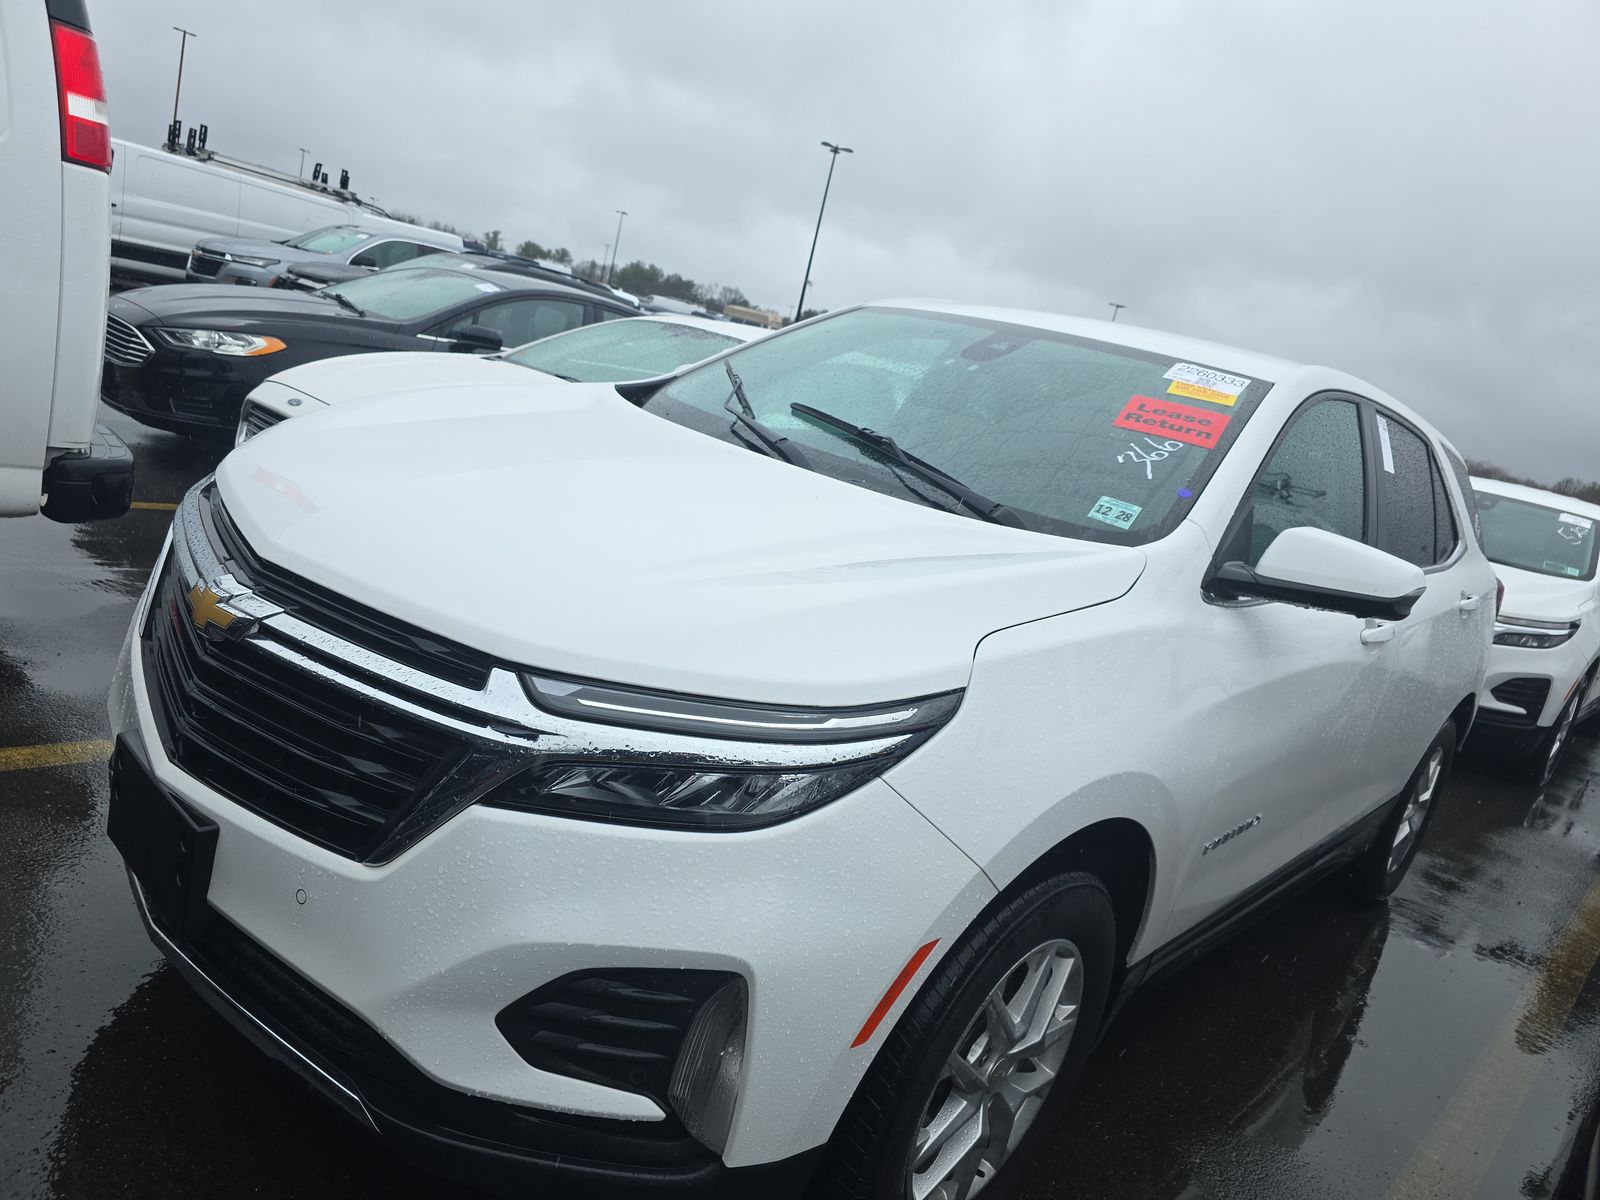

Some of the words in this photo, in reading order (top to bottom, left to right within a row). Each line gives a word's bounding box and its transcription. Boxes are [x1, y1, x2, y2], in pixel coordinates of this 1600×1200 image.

[1177, 365, 1246, 388] 2260333
[1124, 412, 1213, 440] Return
[1136, 403, 1212, 426] Lease
[1094, 504, 1113, 516] 12
[1114, 510, 1133, 522] 28
